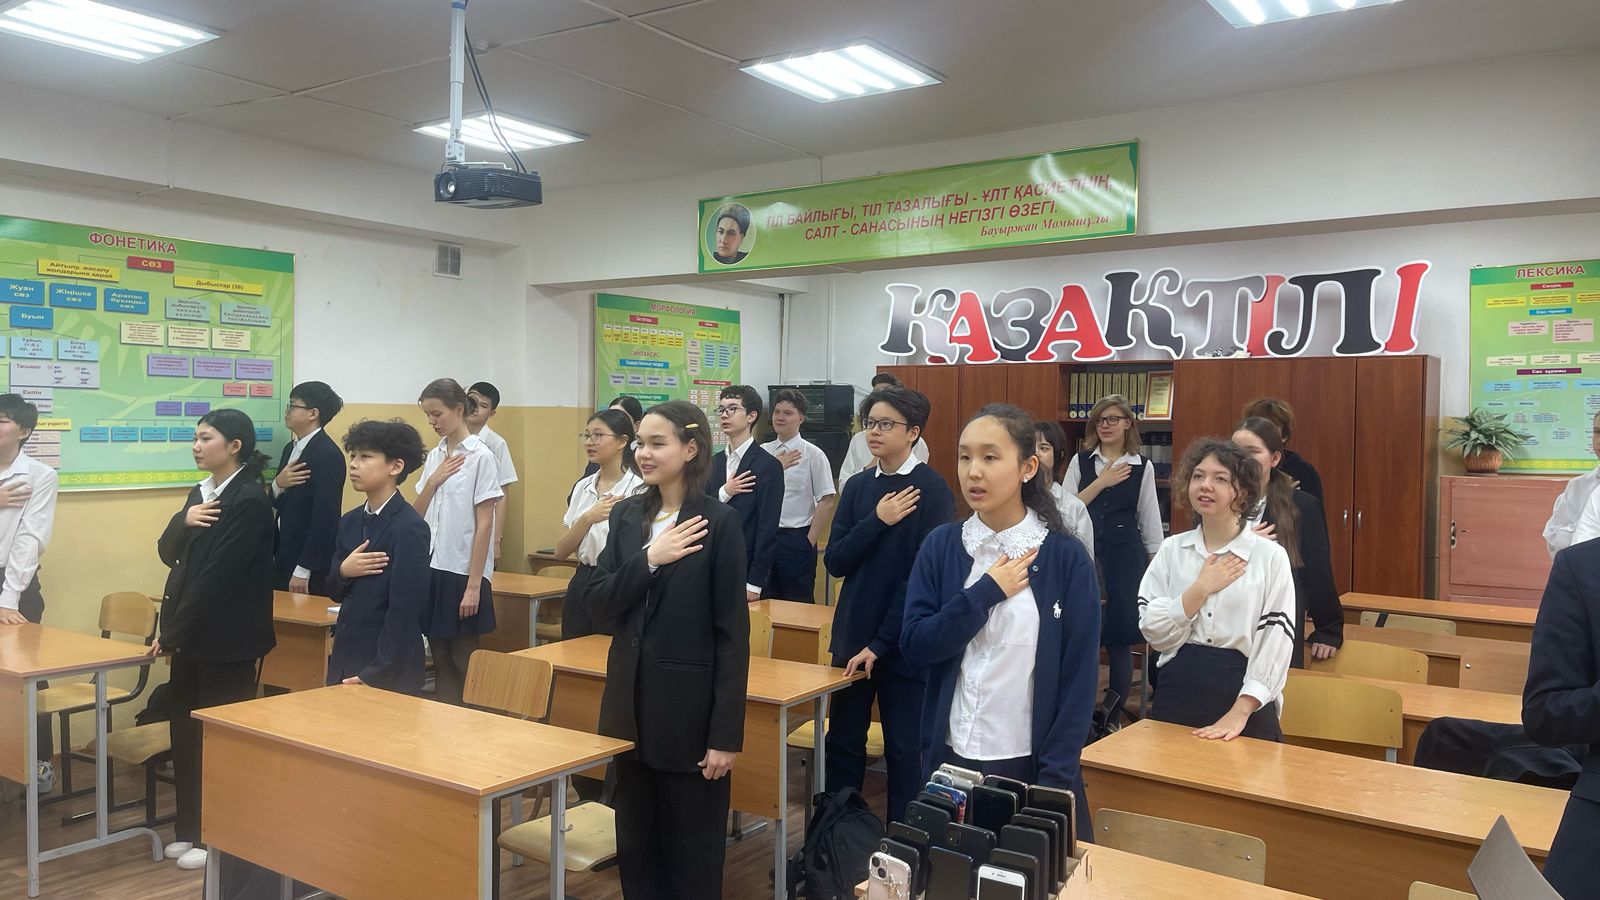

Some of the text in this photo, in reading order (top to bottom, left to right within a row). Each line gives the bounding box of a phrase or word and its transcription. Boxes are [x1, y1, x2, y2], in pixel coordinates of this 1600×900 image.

[766, 215, 784, 228] ТІЛ
[787, 206, 857, 226] БАЙЛЫҒЫ,
[862, 203, 882, 217] ТІЛ
[886, 192, 969, 214] ТАЗАЛЫҒЫ
[981, 187, 1010, 203] ҰЛТ
[805, 225, 840, 240] САЛТ
[851, 213, 945, 236] САНАСЫНЫҢ
[948, 206, 1005, 224] НЕГІЗГІ
[1009, 200, 1058, 218] ӨЗЕГІ.
[980, 222, 1038, 238] Бауыржан
[89, 232, 177, 254] ФОНЕТИКА
[141, 259, 162, 269] СӨЗ
[1515, 265, 1585, 279] ЛЕКСИКА
[9, 283, 34, 292] Жуан
[196, 279, 231, 290] Дыбыстар
[650, 302, 697, 316] МОРФОЛОГИЯ
